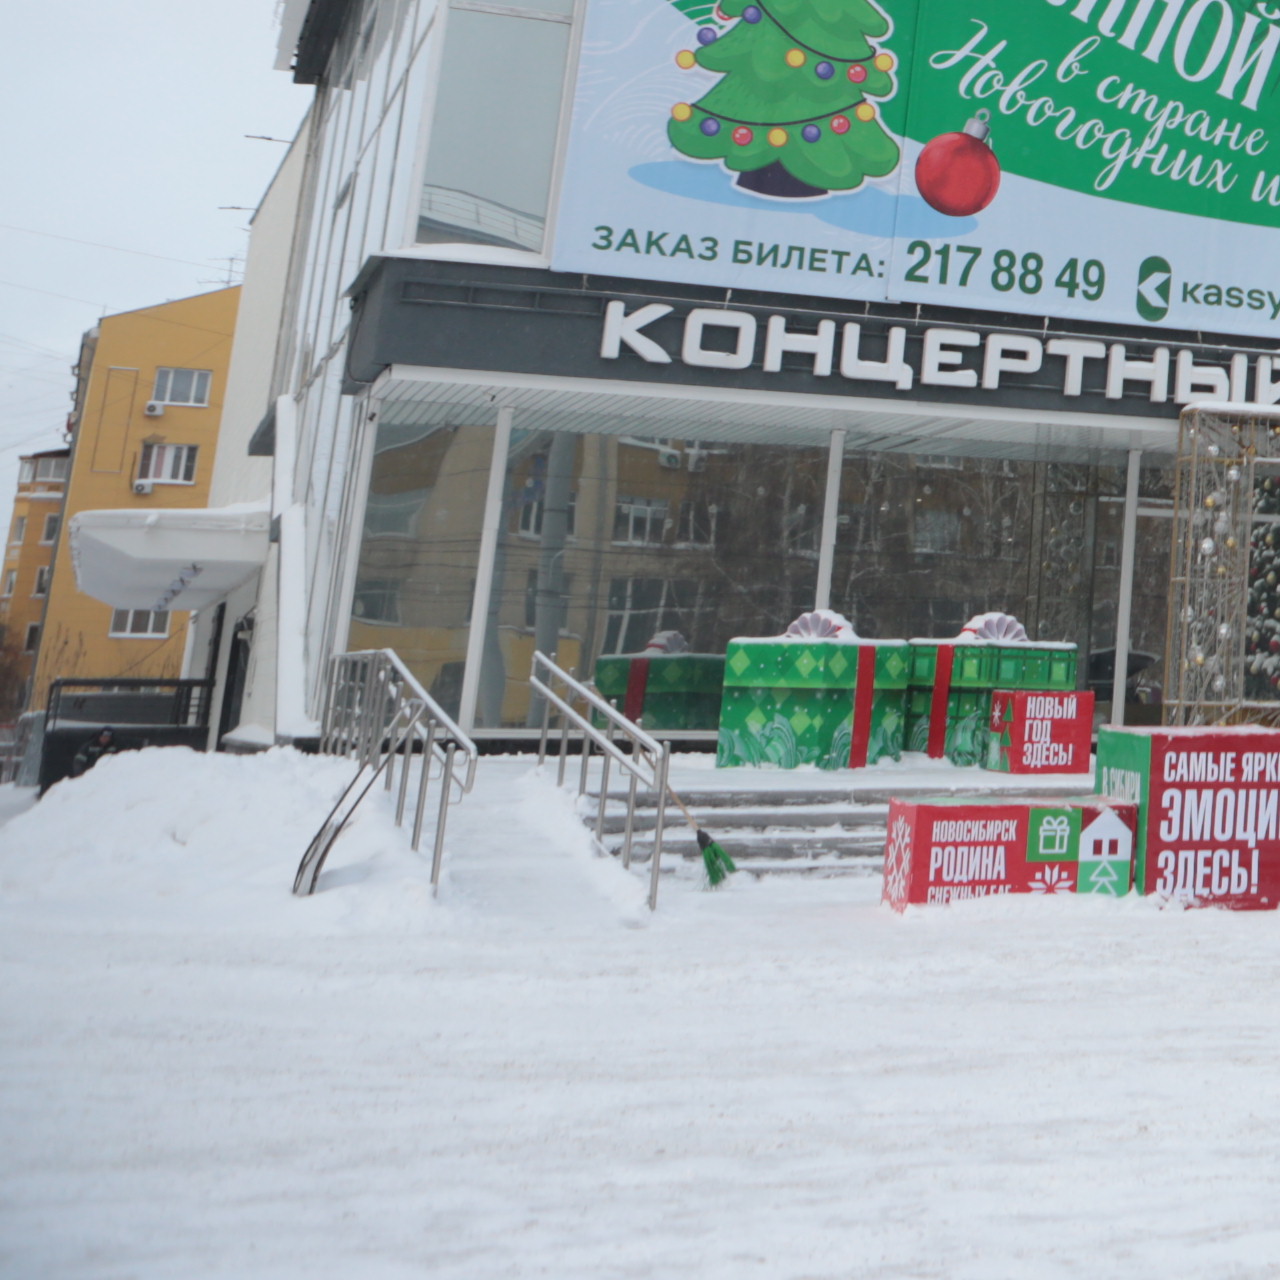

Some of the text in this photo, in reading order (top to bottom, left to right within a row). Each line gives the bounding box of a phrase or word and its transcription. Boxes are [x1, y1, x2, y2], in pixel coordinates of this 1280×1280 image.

[929, 18, 1239, 191] Новогодних
[1056, 35, 1269, 156] в стране
[591, 225, 1107, 302] ЗАКАЗ БИЛЕТА: 217 88 49
[1026, 694, 1077, 719] НОВЫЙ
[1024, 720, 1052, 746] ГОД
[1022, 742, 1073, 768] ЗДЕСЬ!
[1163, 751, 1237, 783] САМЫЕ
[1110, 768, 1141, 802] СИБИРИ
[932, 820, 1017, 843] НОВОСИБИРСК
[929, 845, 1006, 883] РОДИНА
[1156, 849, 1260, 901] ЗДЕСЬ!
